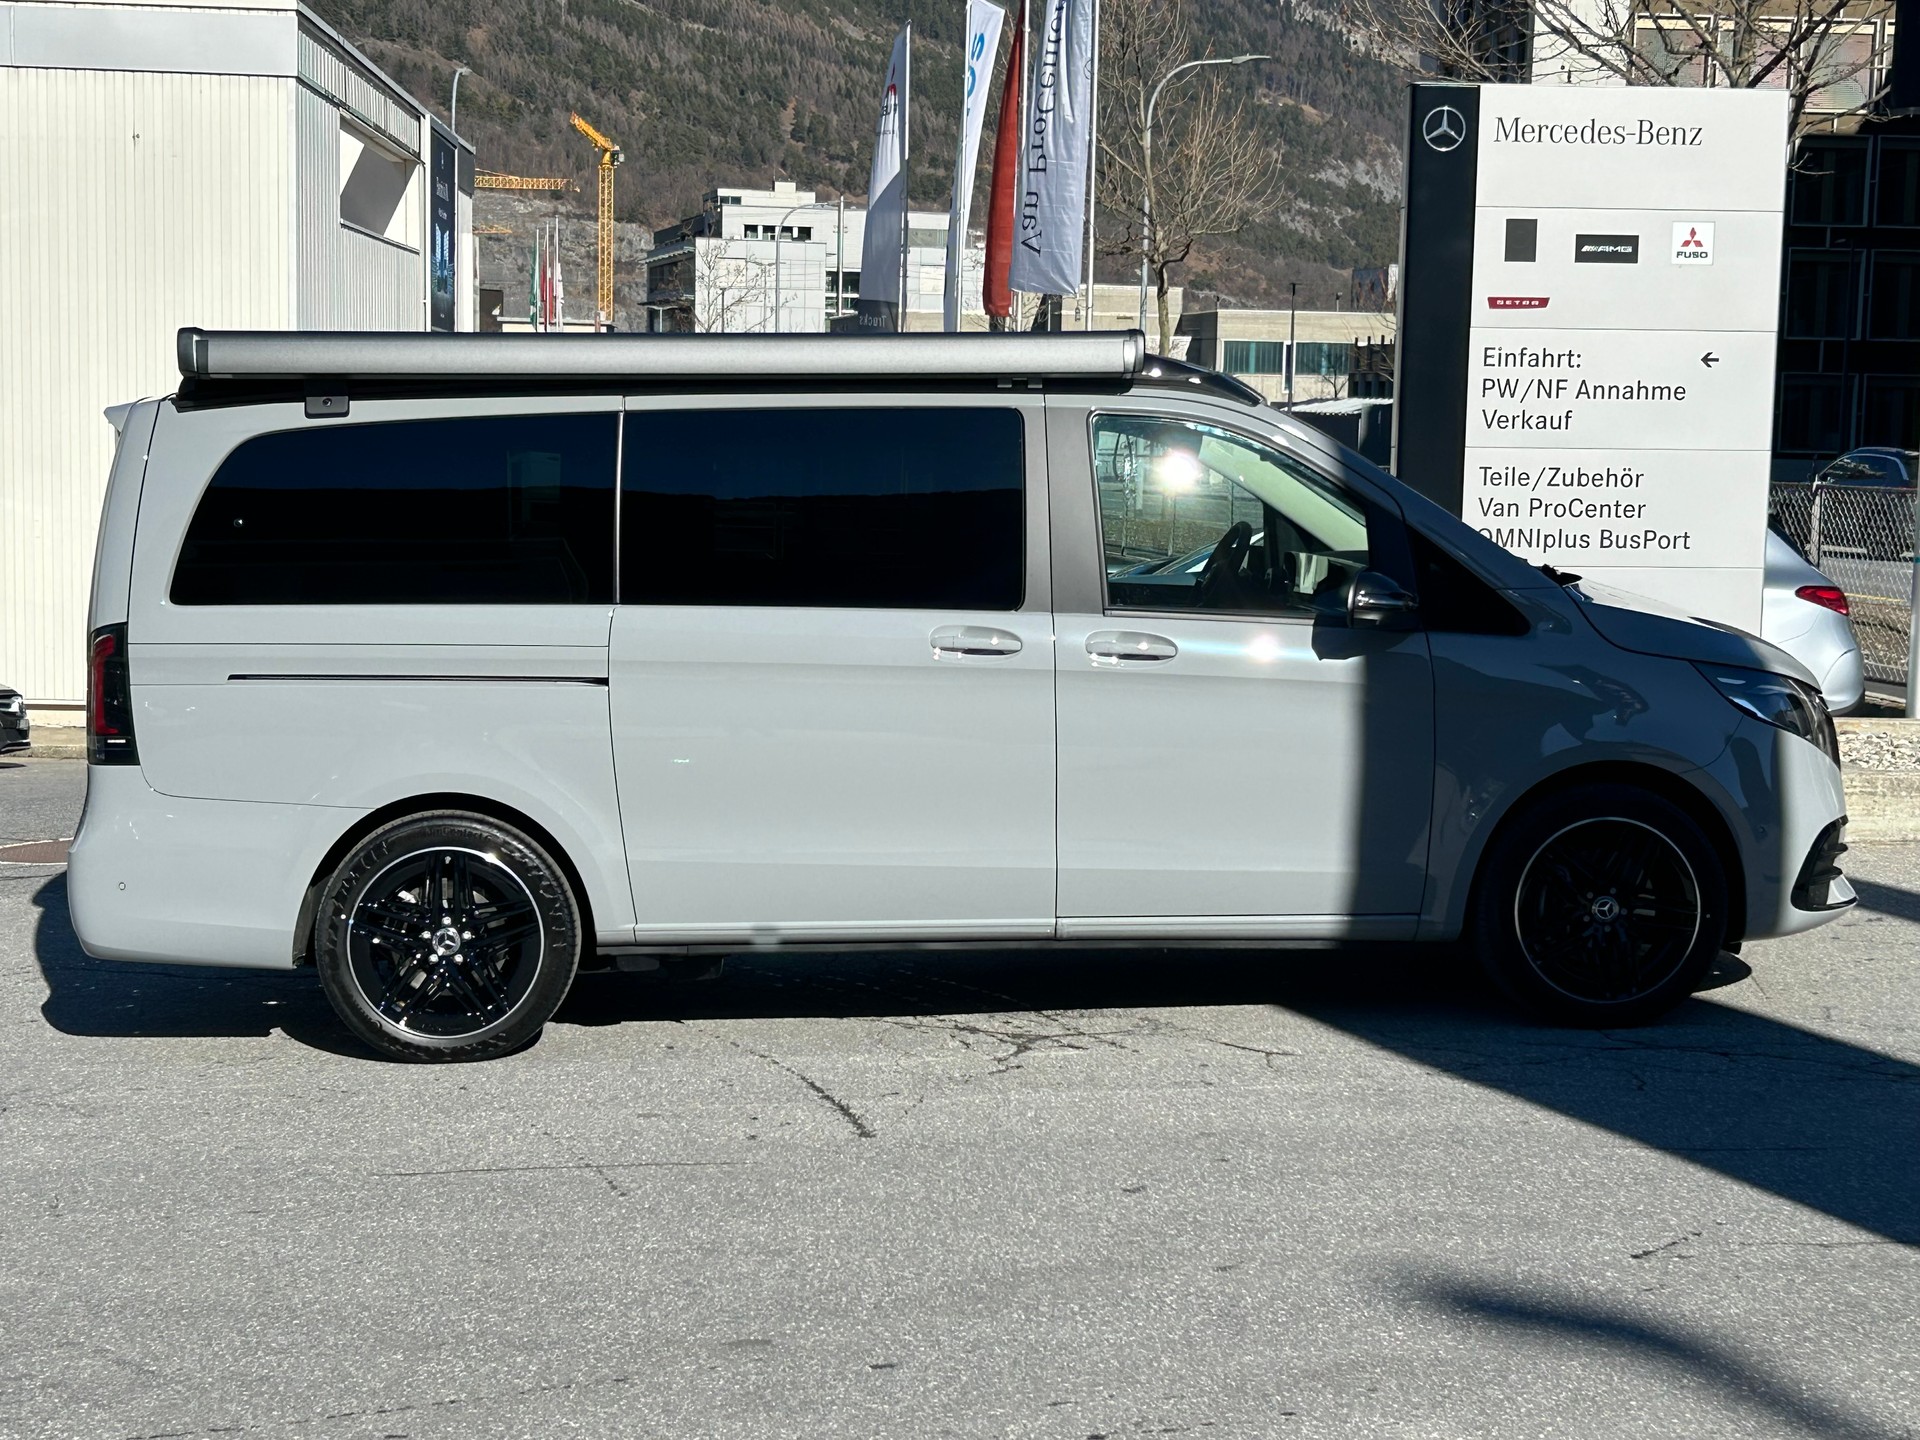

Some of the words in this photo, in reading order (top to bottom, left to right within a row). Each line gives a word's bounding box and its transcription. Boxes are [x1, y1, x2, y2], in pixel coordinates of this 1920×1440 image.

[1493, 117, 1703, 146] Mercedes-Benz
[1676, 251, 1709, 259] FUSO
[1483, 347, 1582, 369] Einfahrt:
[1482, 379, 1569, 404] PW/NF
[1576, 380, 1687, 401] Annahme
[1482, 410, 1573, 431] Verkauf
[1478, 466, 1645, 492] Teile/Zubehör
[1478, 497, 1520, 518] Van
[1529, 498, 1647, 519] ProCenter
[1599, 529, 1691, 550] BusPort
